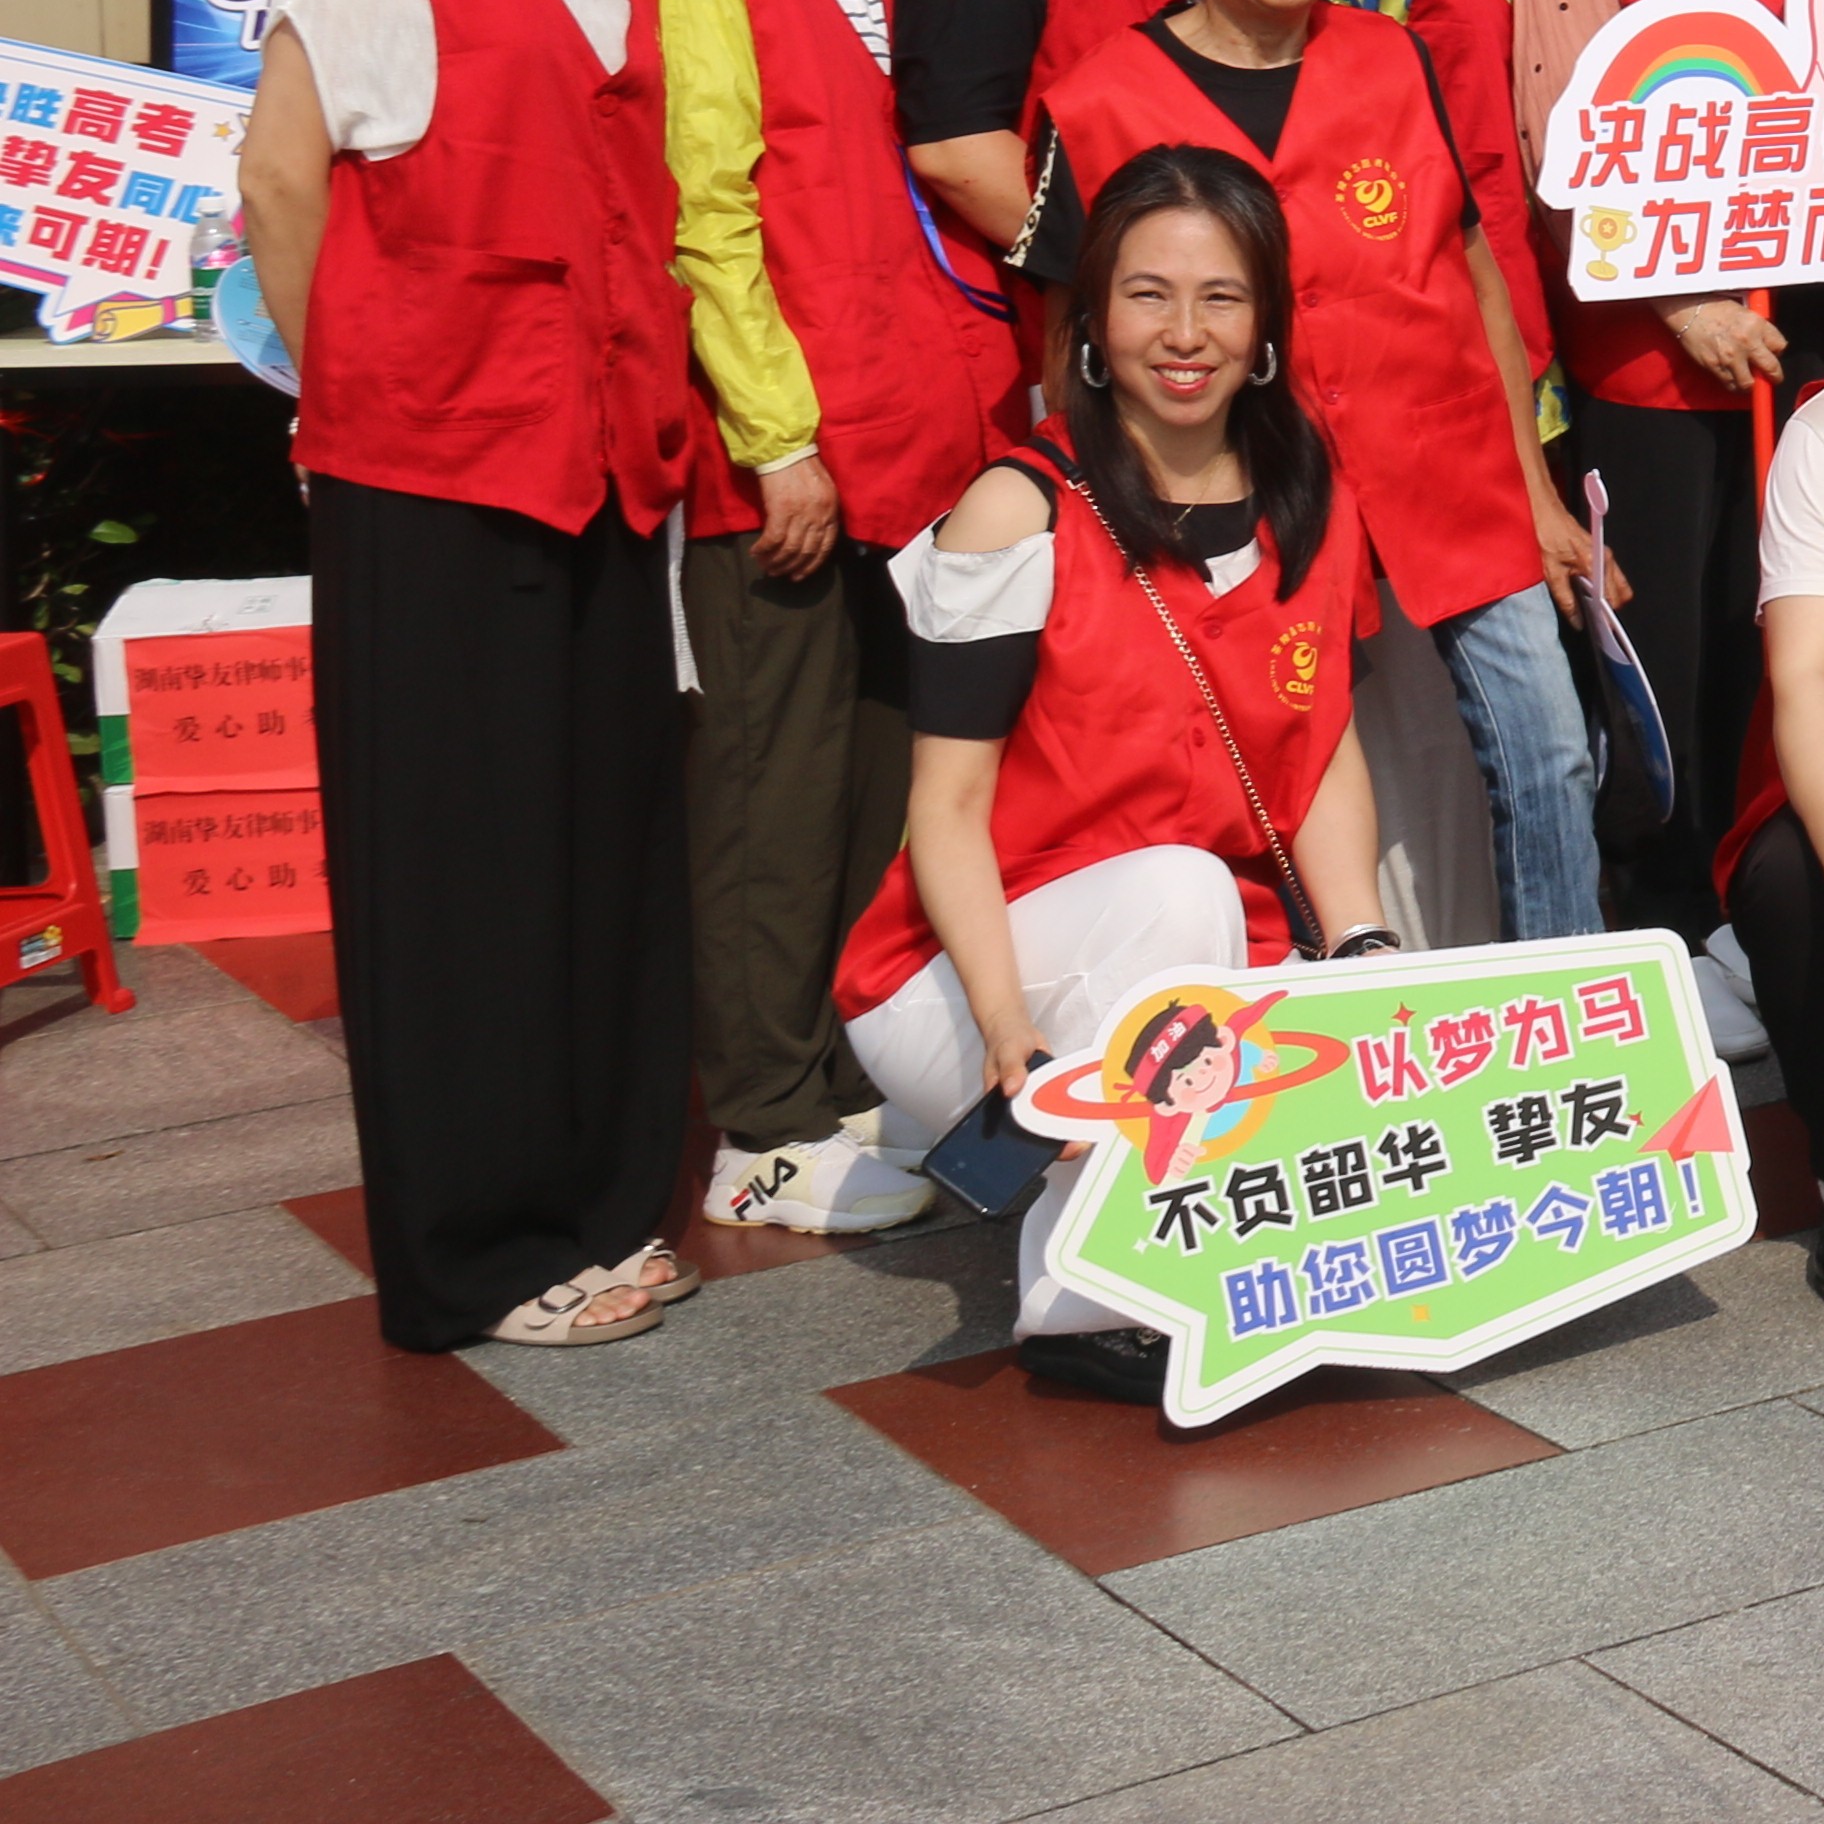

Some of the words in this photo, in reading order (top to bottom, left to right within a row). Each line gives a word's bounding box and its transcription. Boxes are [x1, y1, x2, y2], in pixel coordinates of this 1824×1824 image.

[0, 81, 196, 159] 胜高考
[1150, 1019, 1189, 1064] 加油
[1353, 974, 1652, 1103] 以梦为马
[1148, 1126, 1450, 1253] 不负韶华
[1485, 1076, 1635, 1165] 挚友
